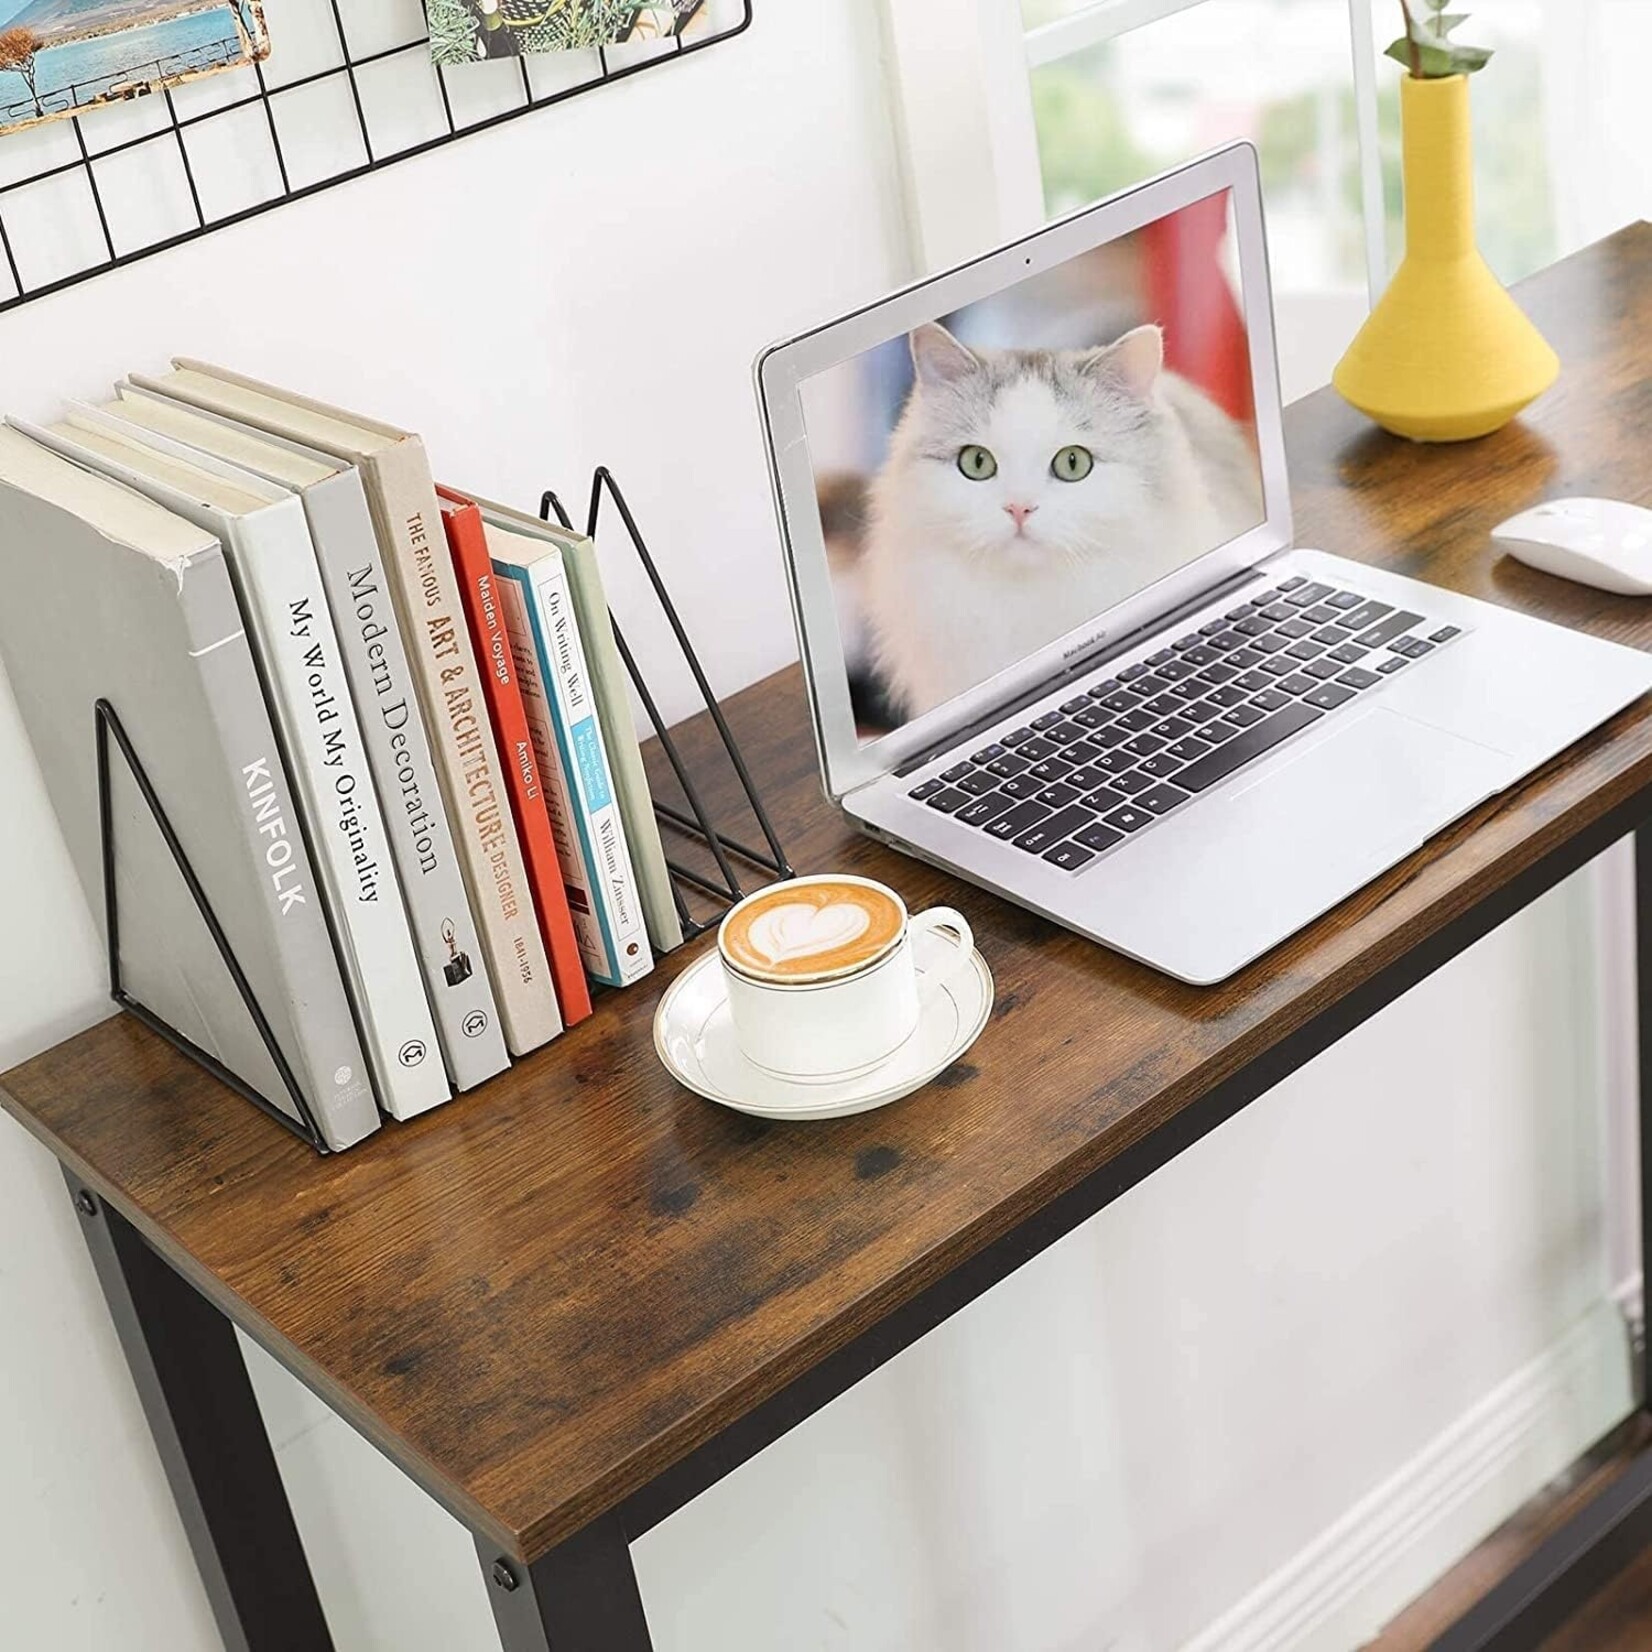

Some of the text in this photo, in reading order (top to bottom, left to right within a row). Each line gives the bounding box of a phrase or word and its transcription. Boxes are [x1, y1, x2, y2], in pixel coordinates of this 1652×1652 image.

[406, 512, 426, 545] THE
[426, 616, 460, 659] ART
[440, 666, 464, 684] &
[478, 575, 511, 686] Maiden Voyage
[548, 591, 585, 707] On Writing Well
[289, 597, 380, 904] My World My Originality
[347, 563, 438, 876] Modern Decoration
[444, 687, 507, 853] ARCHITECTURE
[515, 741, 539, 801] Amiko Li
[242, 757, 306, 916] KINFOLK
[490, 852, 519, 922] DESIGNER
[599, 818, 631, 926] William Zinsser
